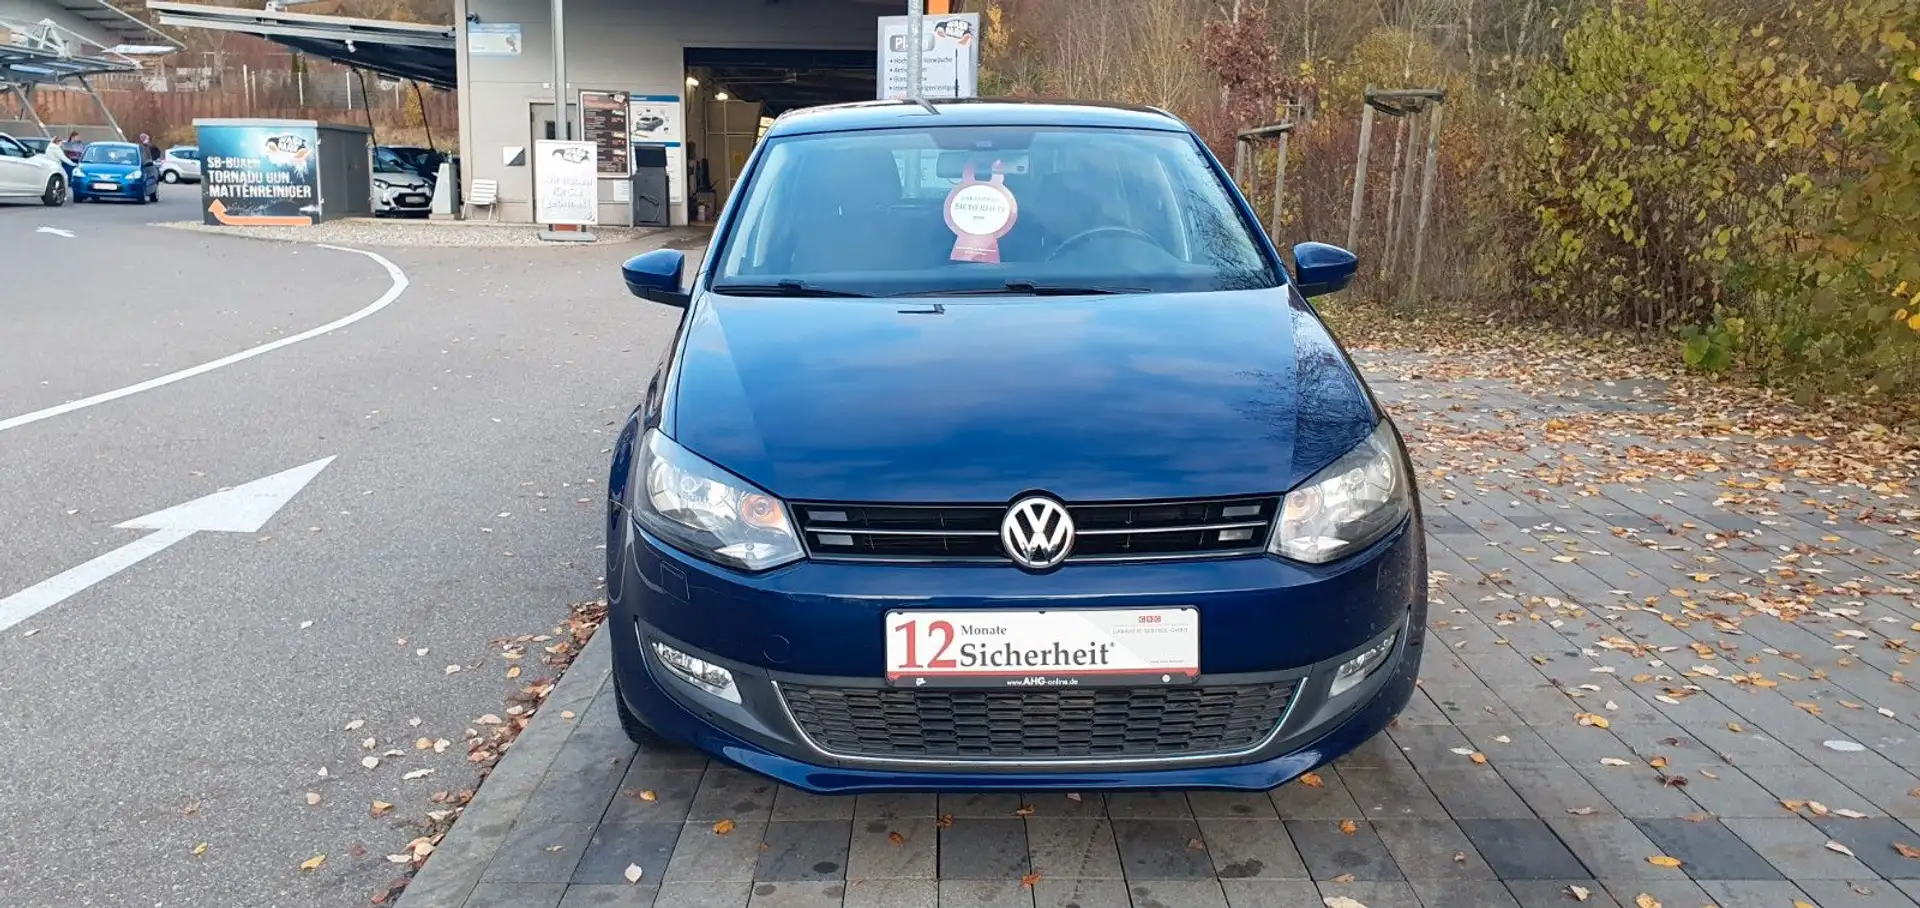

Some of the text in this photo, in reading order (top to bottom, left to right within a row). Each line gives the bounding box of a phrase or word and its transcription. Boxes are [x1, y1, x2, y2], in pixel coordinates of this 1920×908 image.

[207, 170, 263, 184] TORNADO
[209, 184, 312, 198] MATTENREINIGER
[961, 624, 1007, 636] Monate
[895, 619, 957, 669] 12
[1006, 676, 1079, 686] www.AHG-online.de
